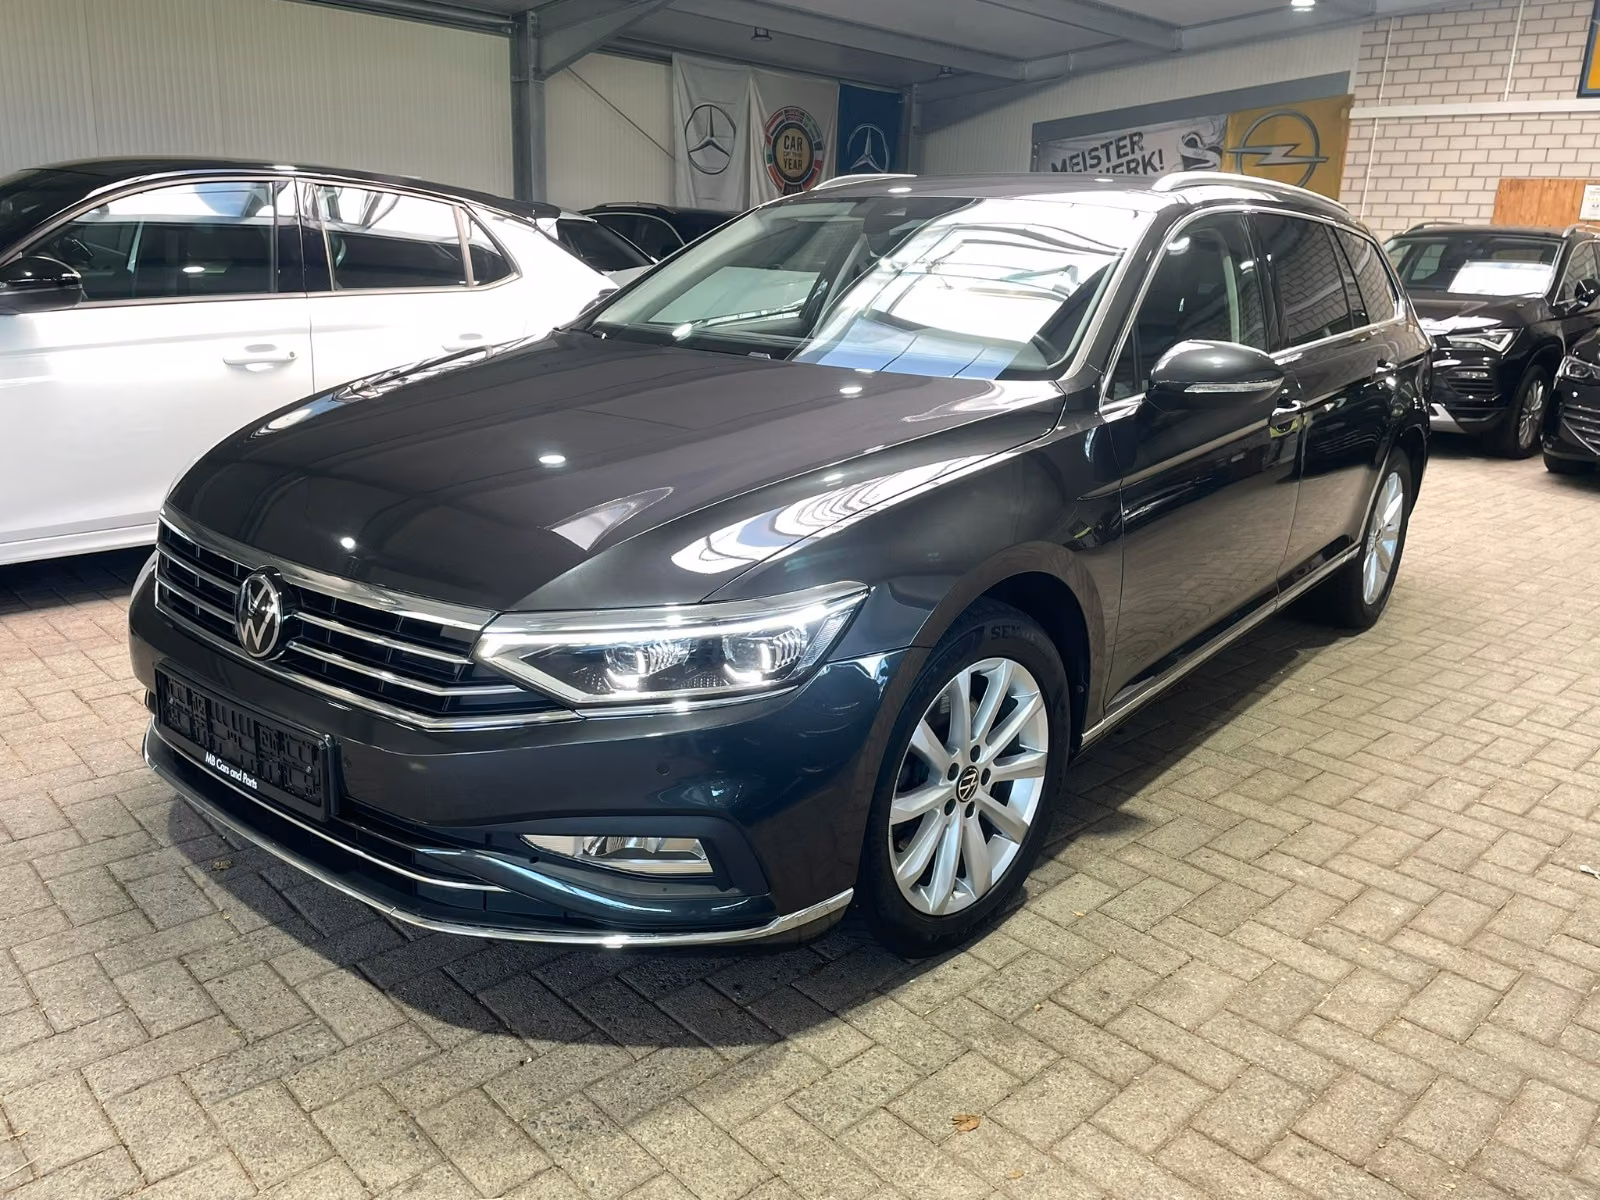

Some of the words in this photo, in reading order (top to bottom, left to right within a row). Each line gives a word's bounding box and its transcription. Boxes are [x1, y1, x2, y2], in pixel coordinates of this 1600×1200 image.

[784, 135, 803, 152] CAR
[1051, 131, 1144, 173] MEISTER
[783, 158, 803, 170] YEAR
[1098, 148, 1164, 175] ERK!
[205, 751, 216, 767] MB
[216, 758, 230, 775] Cars
[230, 769, 243, 782] and
[243, 772, 258, 789] Parts
